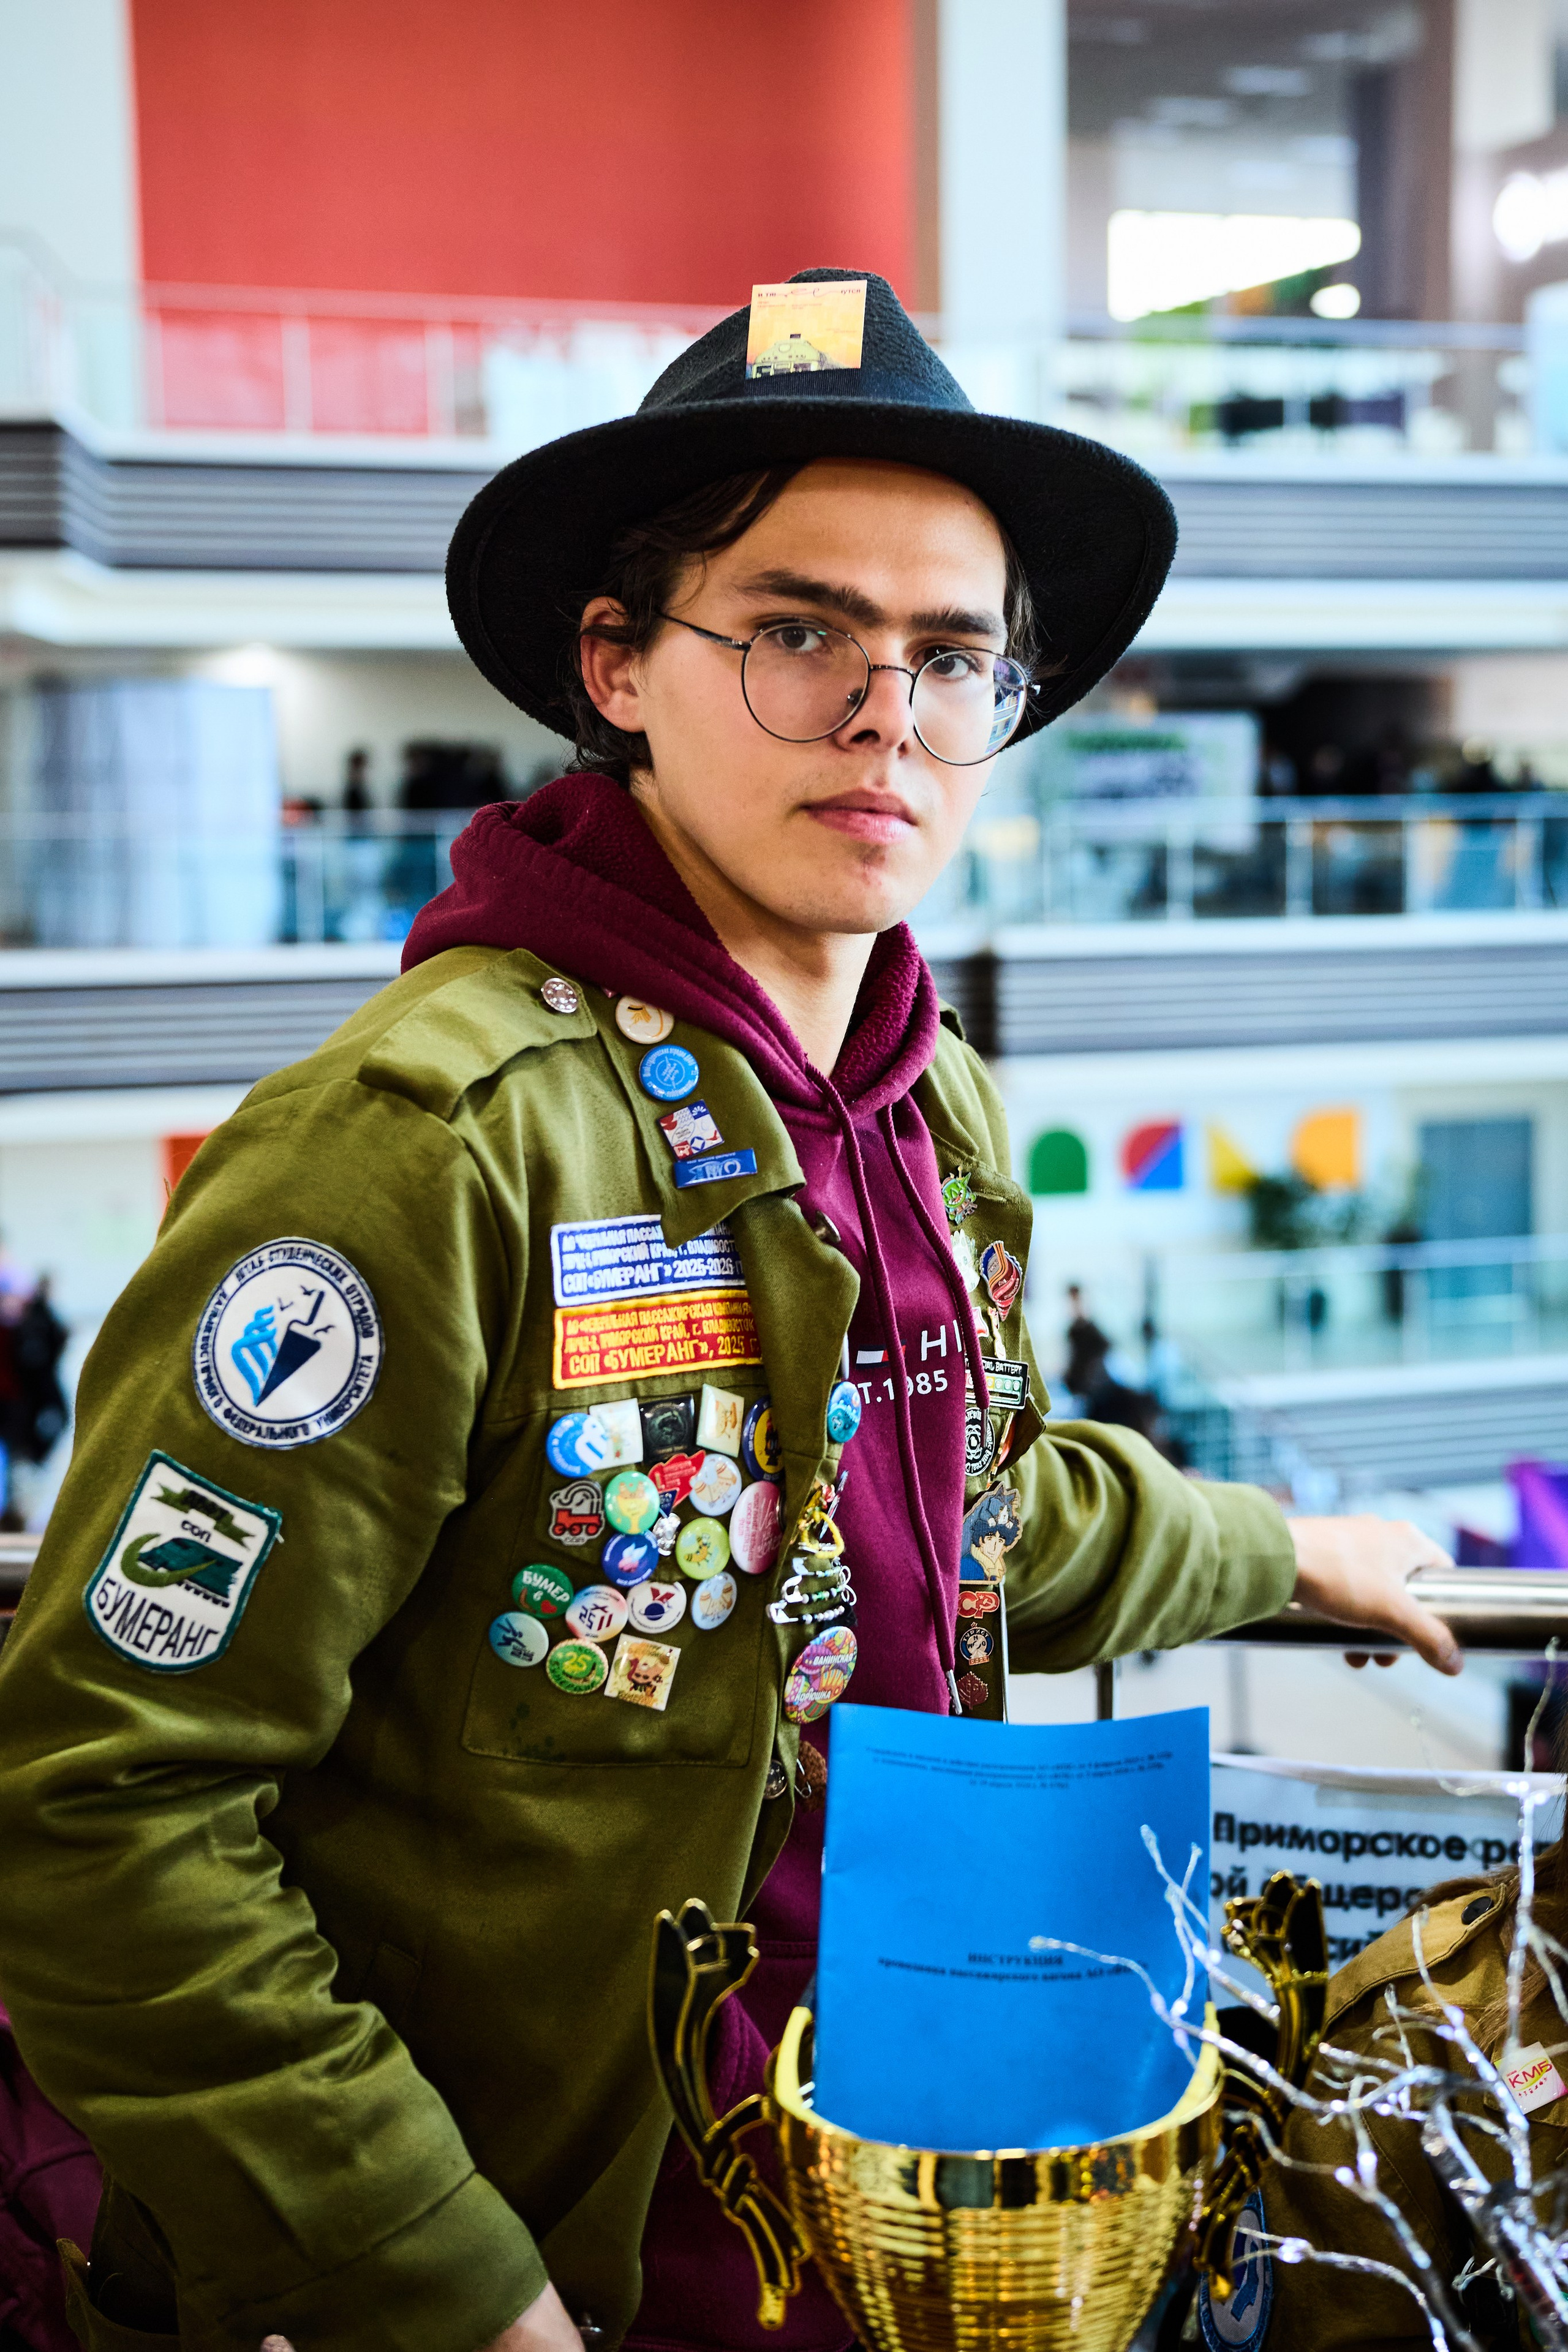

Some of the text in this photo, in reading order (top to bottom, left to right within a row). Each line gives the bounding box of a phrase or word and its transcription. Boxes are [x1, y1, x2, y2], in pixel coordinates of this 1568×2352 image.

[687, 1238, 739, 1255] ВЛАДИВОСТ
[673, 1257, 735, 1279] 2025-2026
[568, 1353, 600, 1376] СОП
[717, 1335, 745, 1355] 2025
[995, 1361, 1023, 1374] BATTERY
[521, 1570, 571, 1604] БУМЕР
[96, 1576, 219, 1659] БУМЕРАНГ
[812, 1653, 854, 1667] ВАНИНСКАЯ
[794, 1687, 832, 1703] КОРЮШКА
[1213, 1811, 1468, 1863] Приморское
[1508, 2060, 1553, 2089] КМБ
